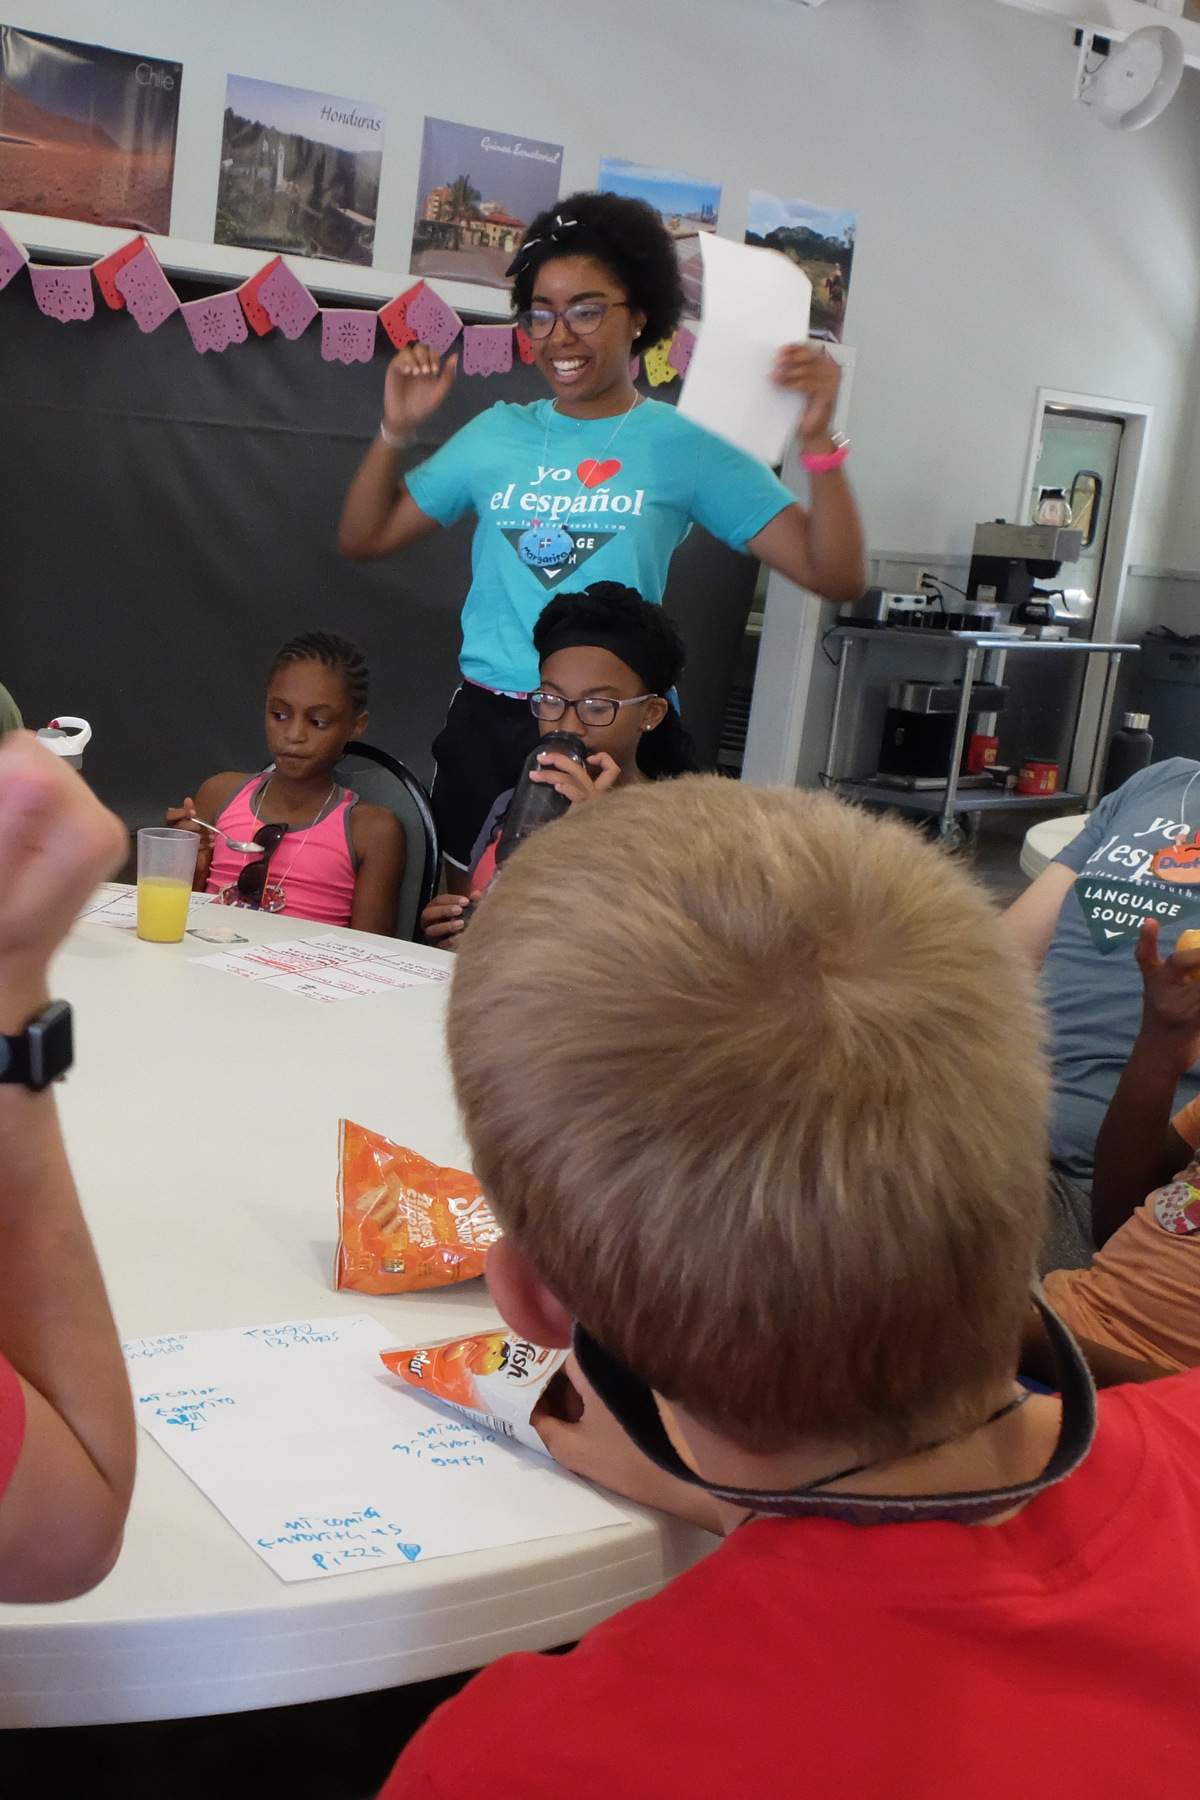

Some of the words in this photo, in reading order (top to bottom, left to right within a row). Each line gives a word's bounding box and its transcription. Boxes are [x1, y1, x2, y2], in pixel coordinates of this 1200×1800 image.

[134, 62, 175, 91] Chile
[320, 105, 381, 131] Honduras
[530, 466, 572, 485] yo
[490, 484, 516, 510] el
[519, 487, 644, 520] español
[1133, 817, 1191, 840] yo
[1084, 886, 1181, 916] LANGUAGE
[507, 1341, 536, 1379] fish
